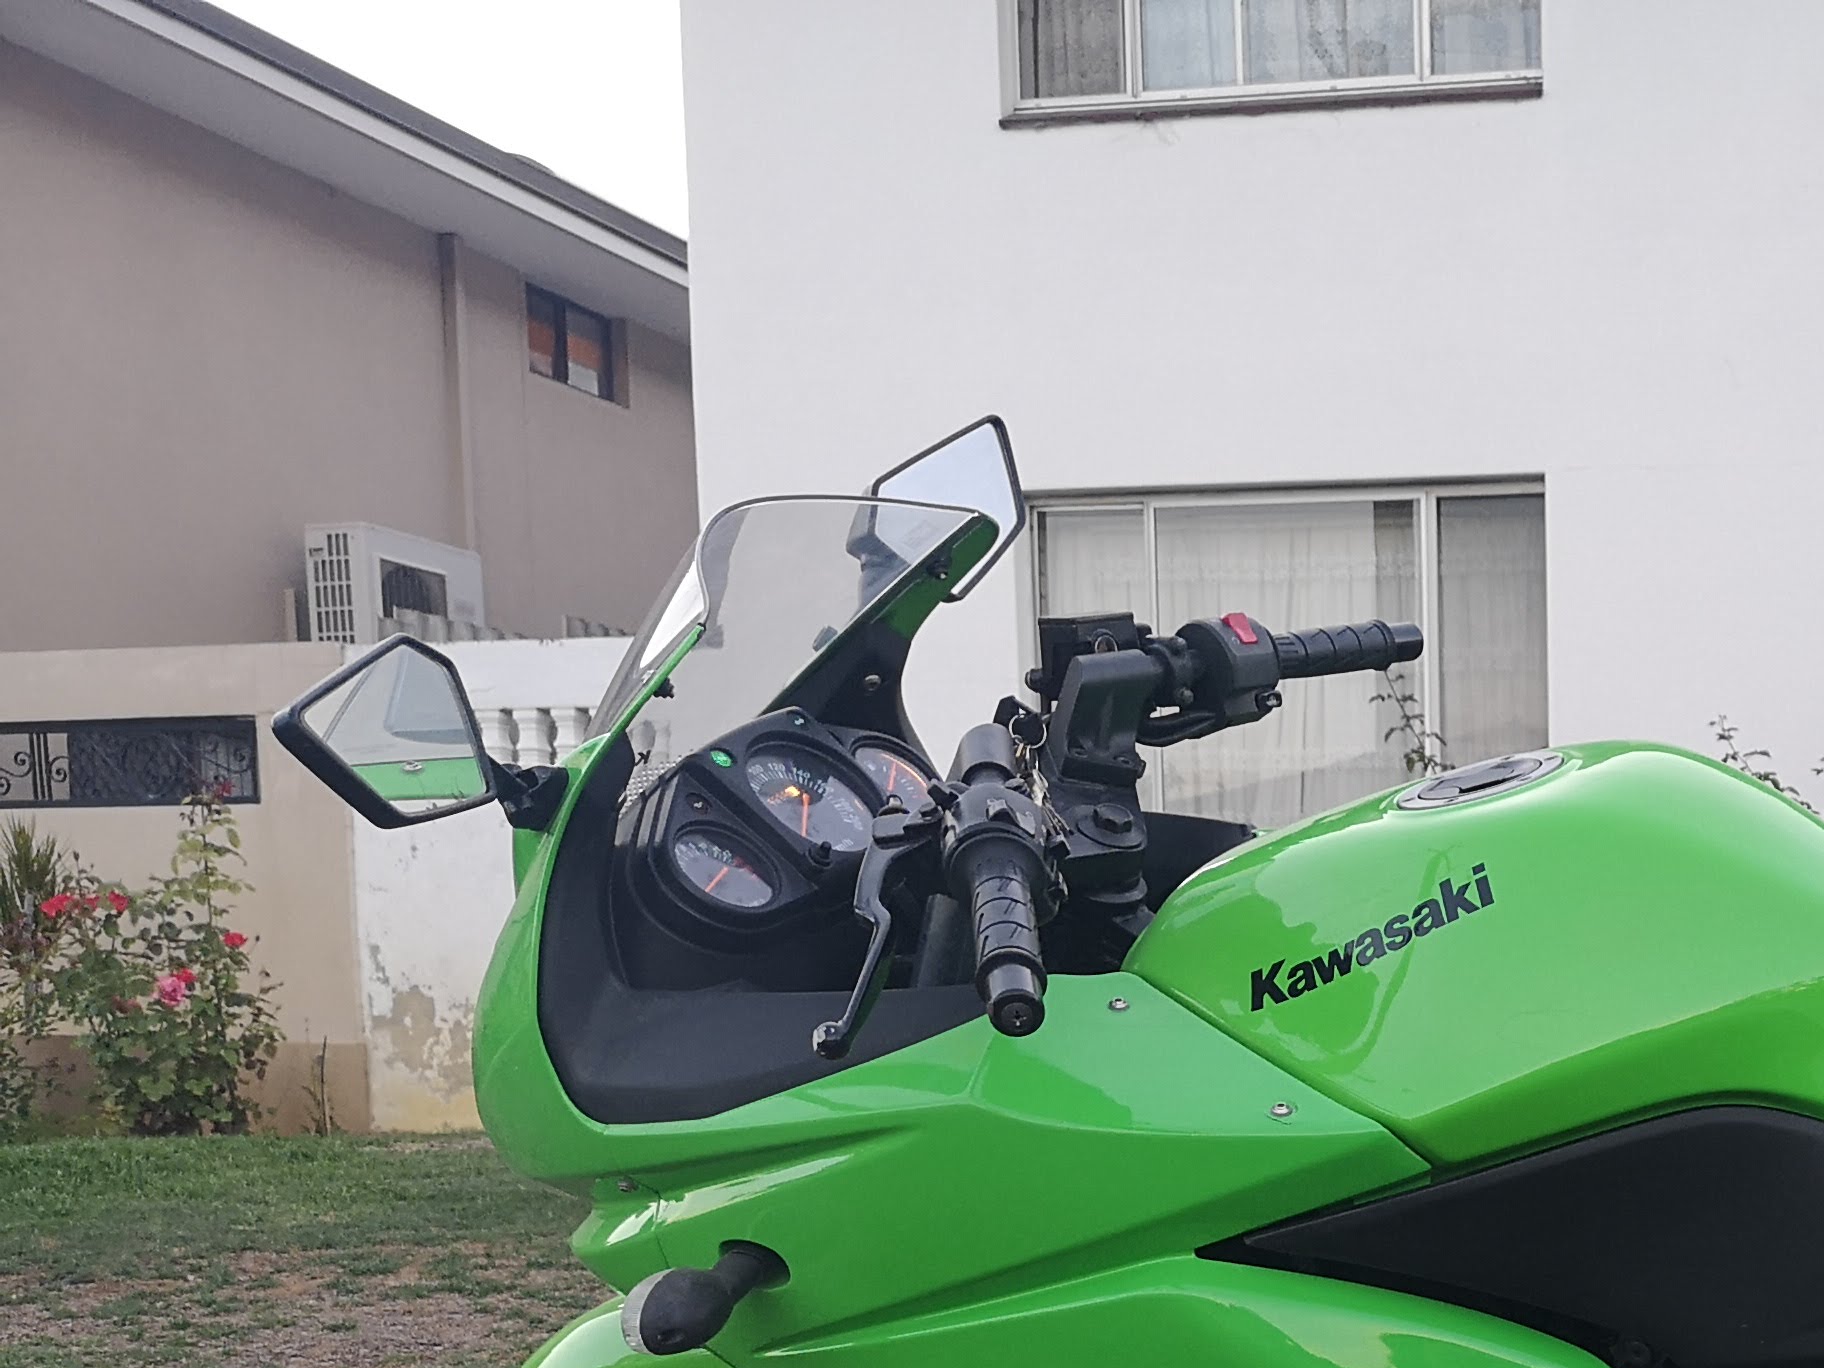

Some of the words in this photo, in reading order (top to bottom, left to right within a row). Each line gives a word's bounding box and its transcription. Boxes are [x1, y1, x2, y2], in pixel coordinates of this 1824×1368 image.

[767, 762, 785, 772] 120
[793, 767, 810, 778] 140
[1250, 862, 1495, 1012] Kawasaki
